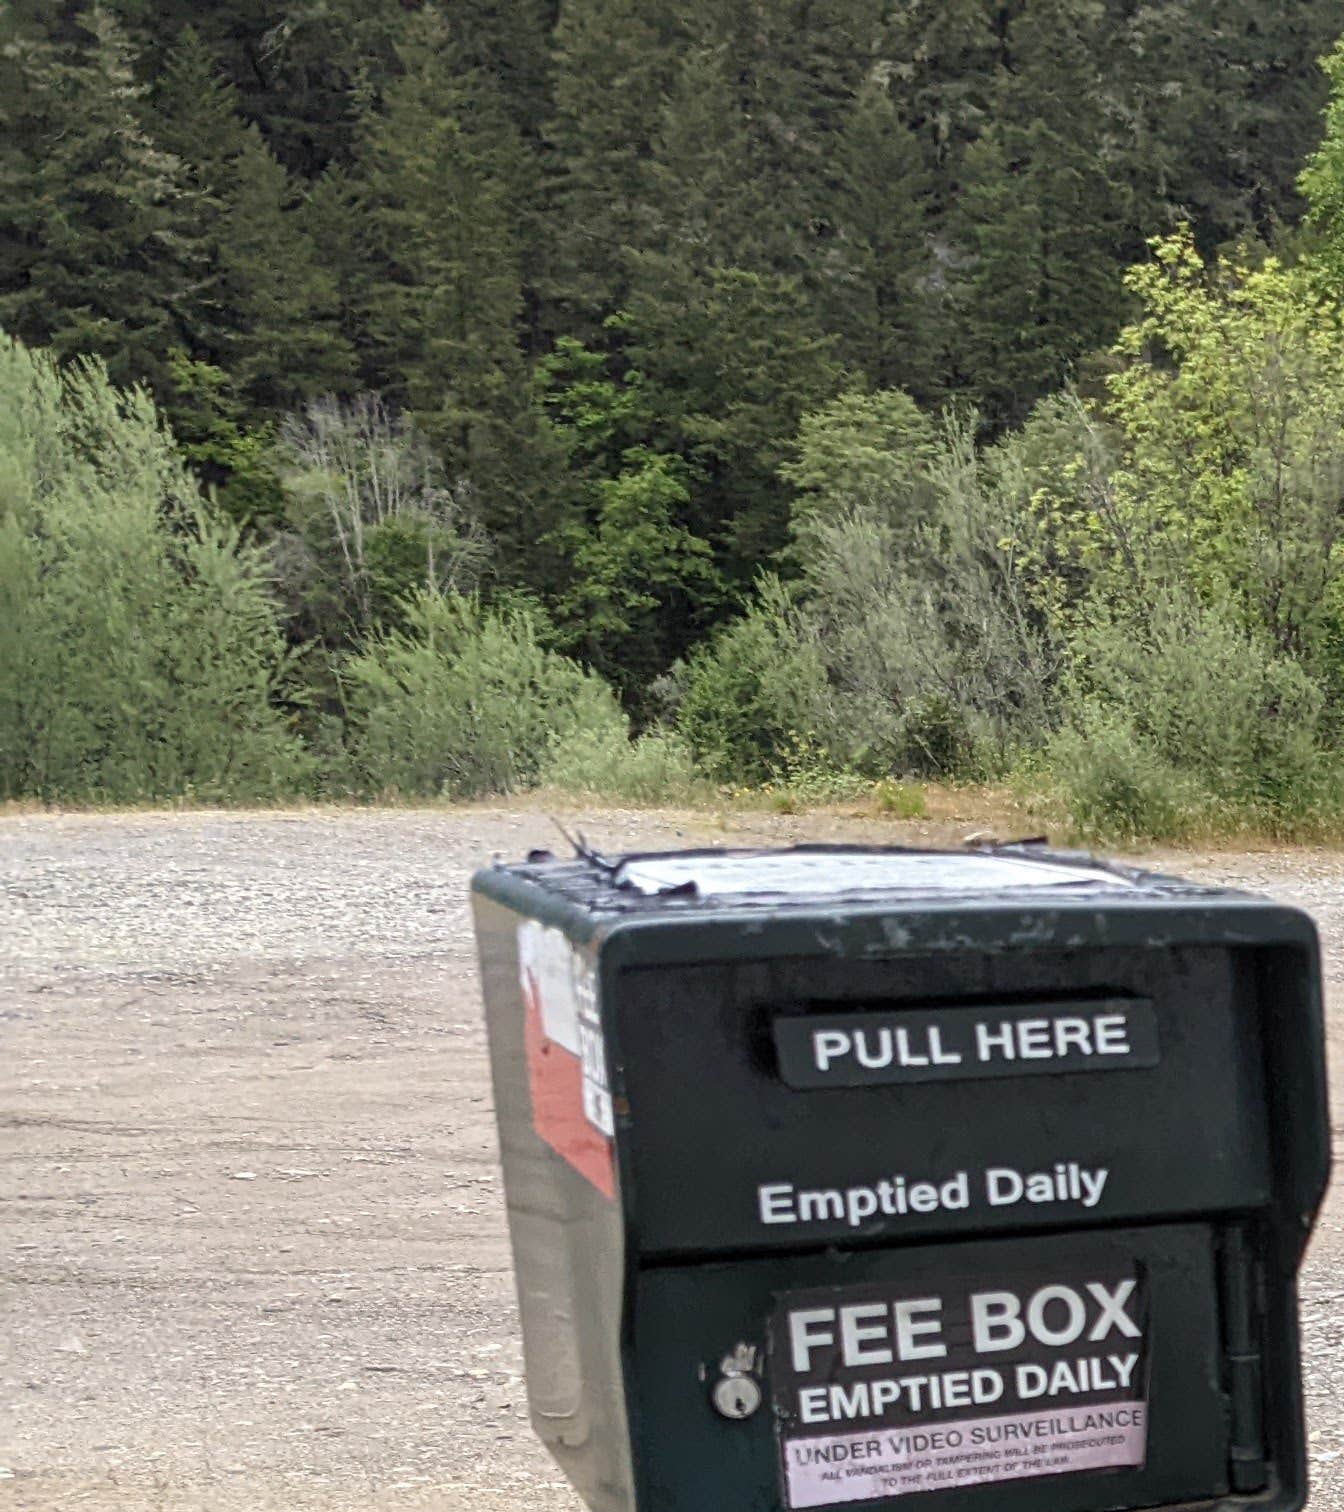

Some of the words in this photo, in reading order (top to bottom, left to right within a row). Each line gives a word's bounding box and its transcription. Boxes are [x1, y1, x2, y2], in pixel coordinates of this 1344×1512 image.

[812, 1025, 962, 1071] PULL
[975, 1013, 1131, 1061] HERE
[757, 1170, 969, 1226] Emptied
[985, 1161, 1110, 1207] Daily
[788, 1297, 947, 1372] FEE
[969, 1280, 1142, 1353] BOX
[798, 1369, 1003, 1423] EMPTIED
[1015, 1353, 1140, 1400] DAILY
[795, 1440, 882, 1465] UNDER
[889, 1430, 963, 1454] VIDEO
[971, 1410, 1142, 1444] SURVEILLANCE
[821, 1470, 842, 1481] ALL
[846, 1462, 913, 1478] VANDALISM
[936, 1448, 1000, 1466] TAMPERING
[1004, 1446, 1029, 1457] WILL
[1033, 1444, 1049, 1454] BE
[1050, 1435, 1126, 1451] PROSECUTED
[882, 1477, 897, 1487] TO
[901, 1474, 922, 1485] THE
[926, 1471, 953, 1482] FULL
[957, 1464, 1001, 1479] EXTENT
[1004, 1461, 1018, 1472] OF
[1023, 1458, 1042, 1469] THE
